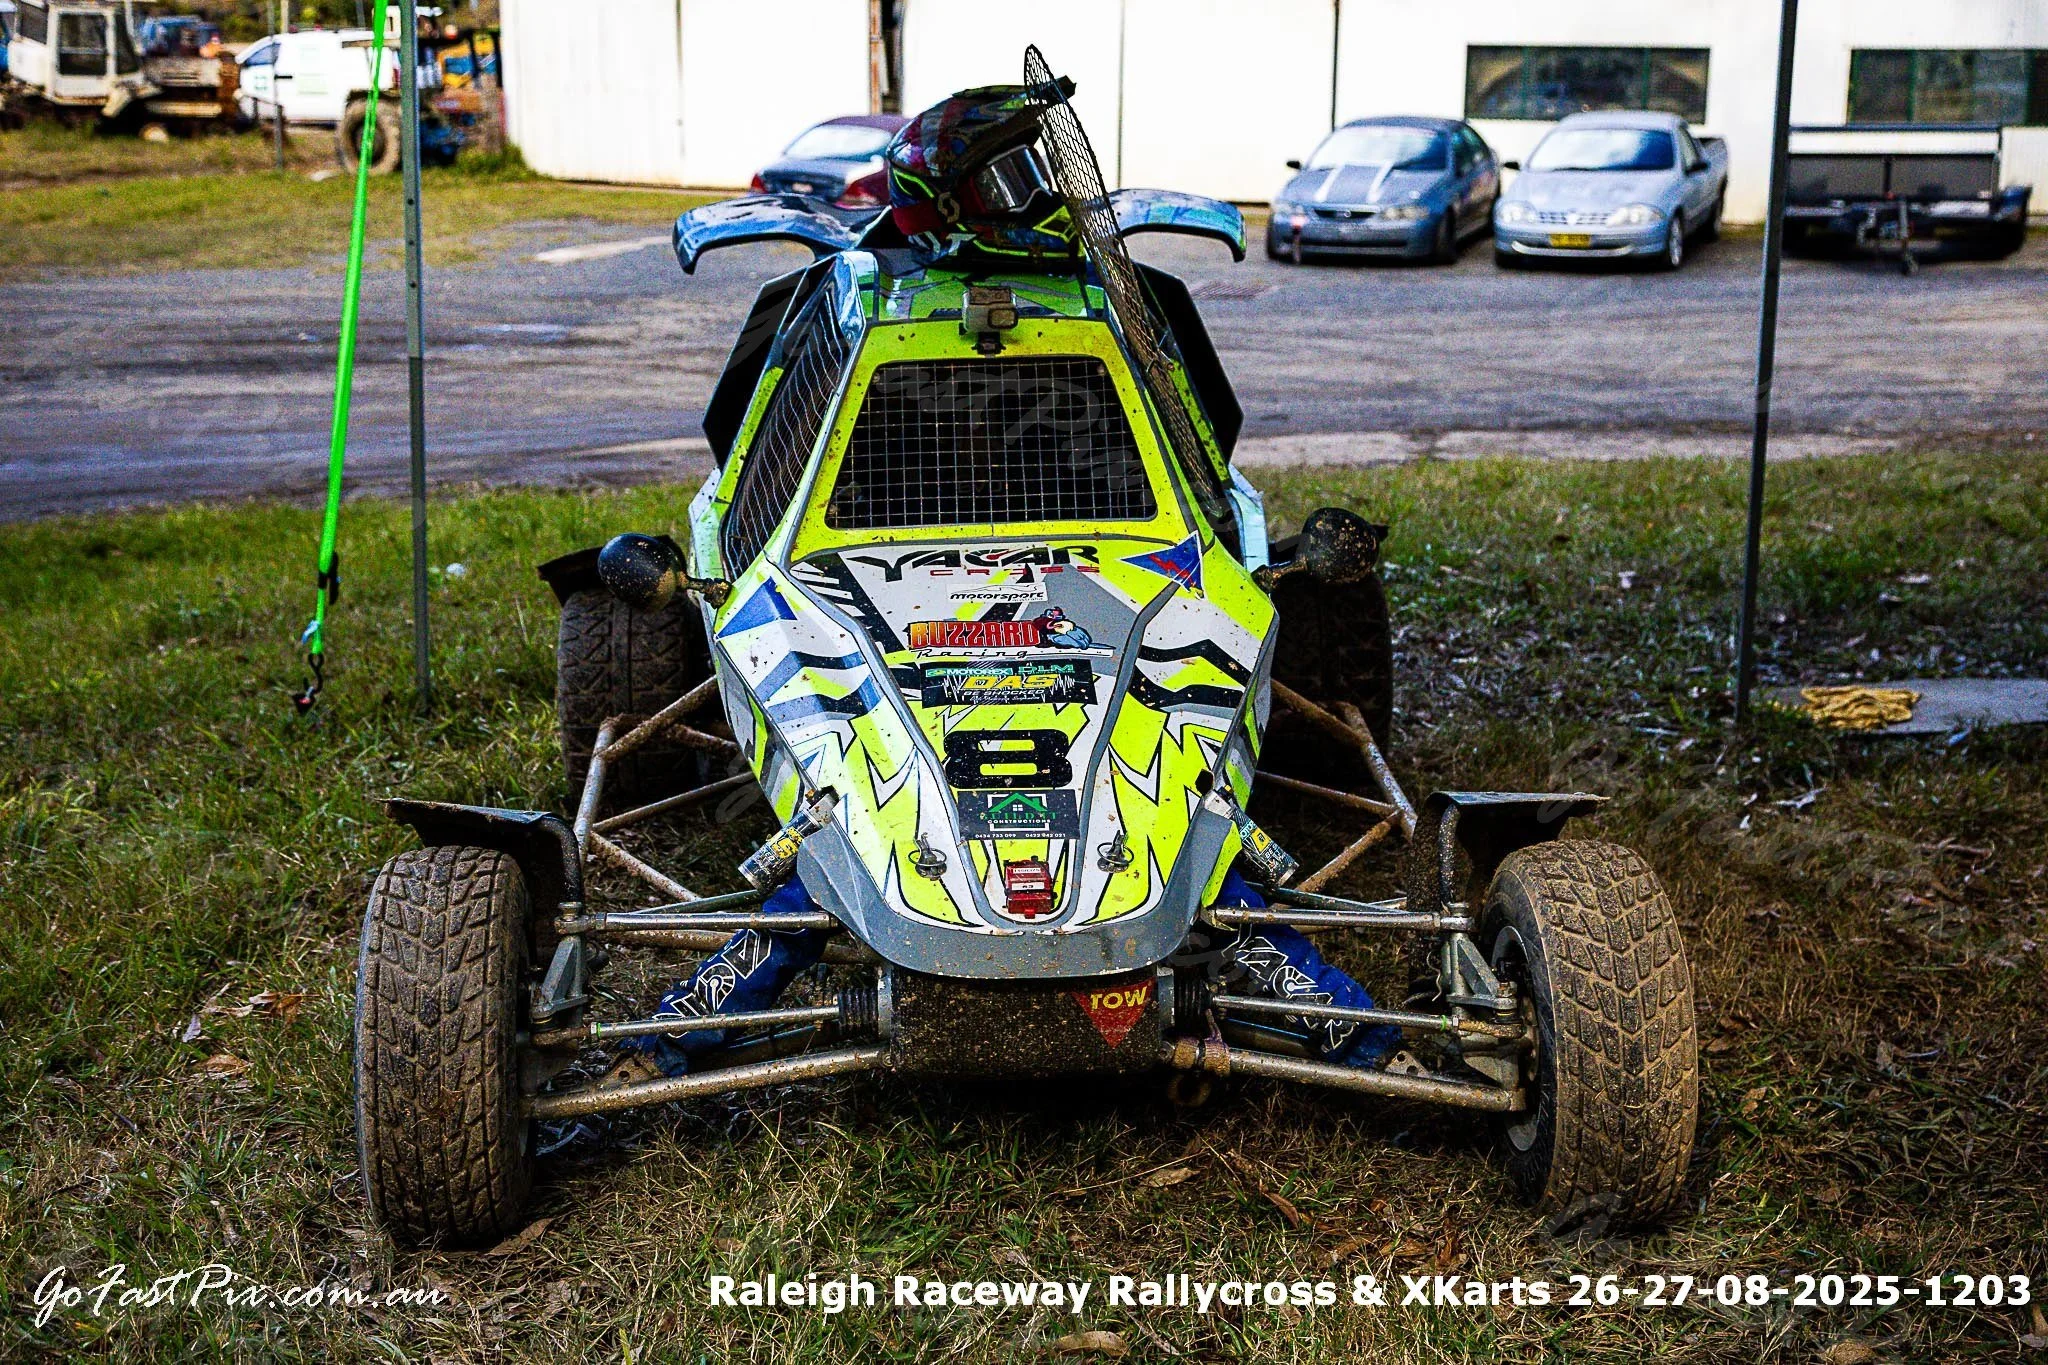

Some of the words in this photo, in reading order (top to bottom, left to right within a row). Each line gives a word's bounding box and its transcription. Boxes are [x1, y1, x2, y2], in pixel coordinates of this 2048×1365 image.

[950, 590, 1044, 602] motorsport
[909, 621, 1040, 648] BUZZARD
[911, 649, 1028, 660] Racing
[946, 668, 1009, 677] MOTOREX
[959, 673, 1059, 690] DAS
[986, 688, 1045, 697] SHOCKED
[943, 728, 1073, 789] 8
[1090, 986, 1148, 1009] TOW
